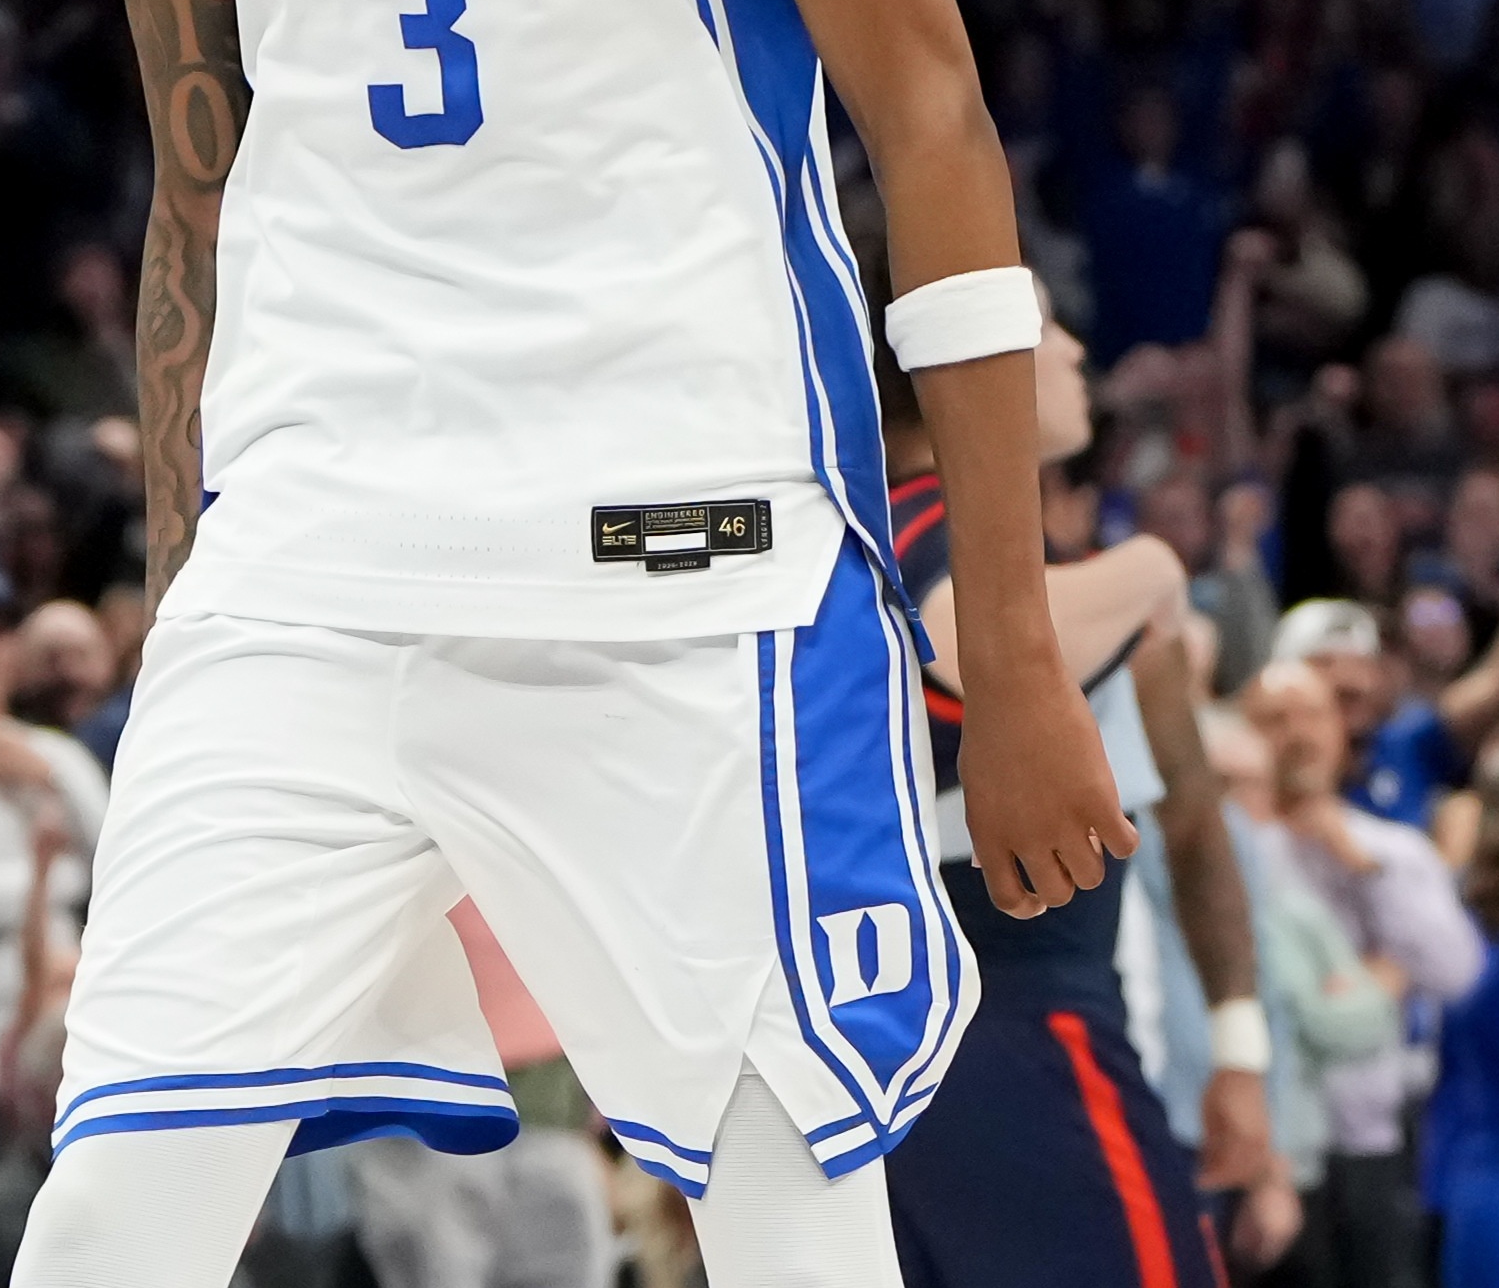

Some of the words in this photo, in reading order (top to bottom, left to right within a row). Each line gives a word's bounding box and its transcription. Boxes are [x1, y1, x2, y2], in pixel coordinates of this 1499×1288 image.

[645, 508, 705, 521] ENGINEERED
[718, 516, 746, 538] 46
[602, 535, 637, 546] ELITE
[816, 903, 912, 1008] D
